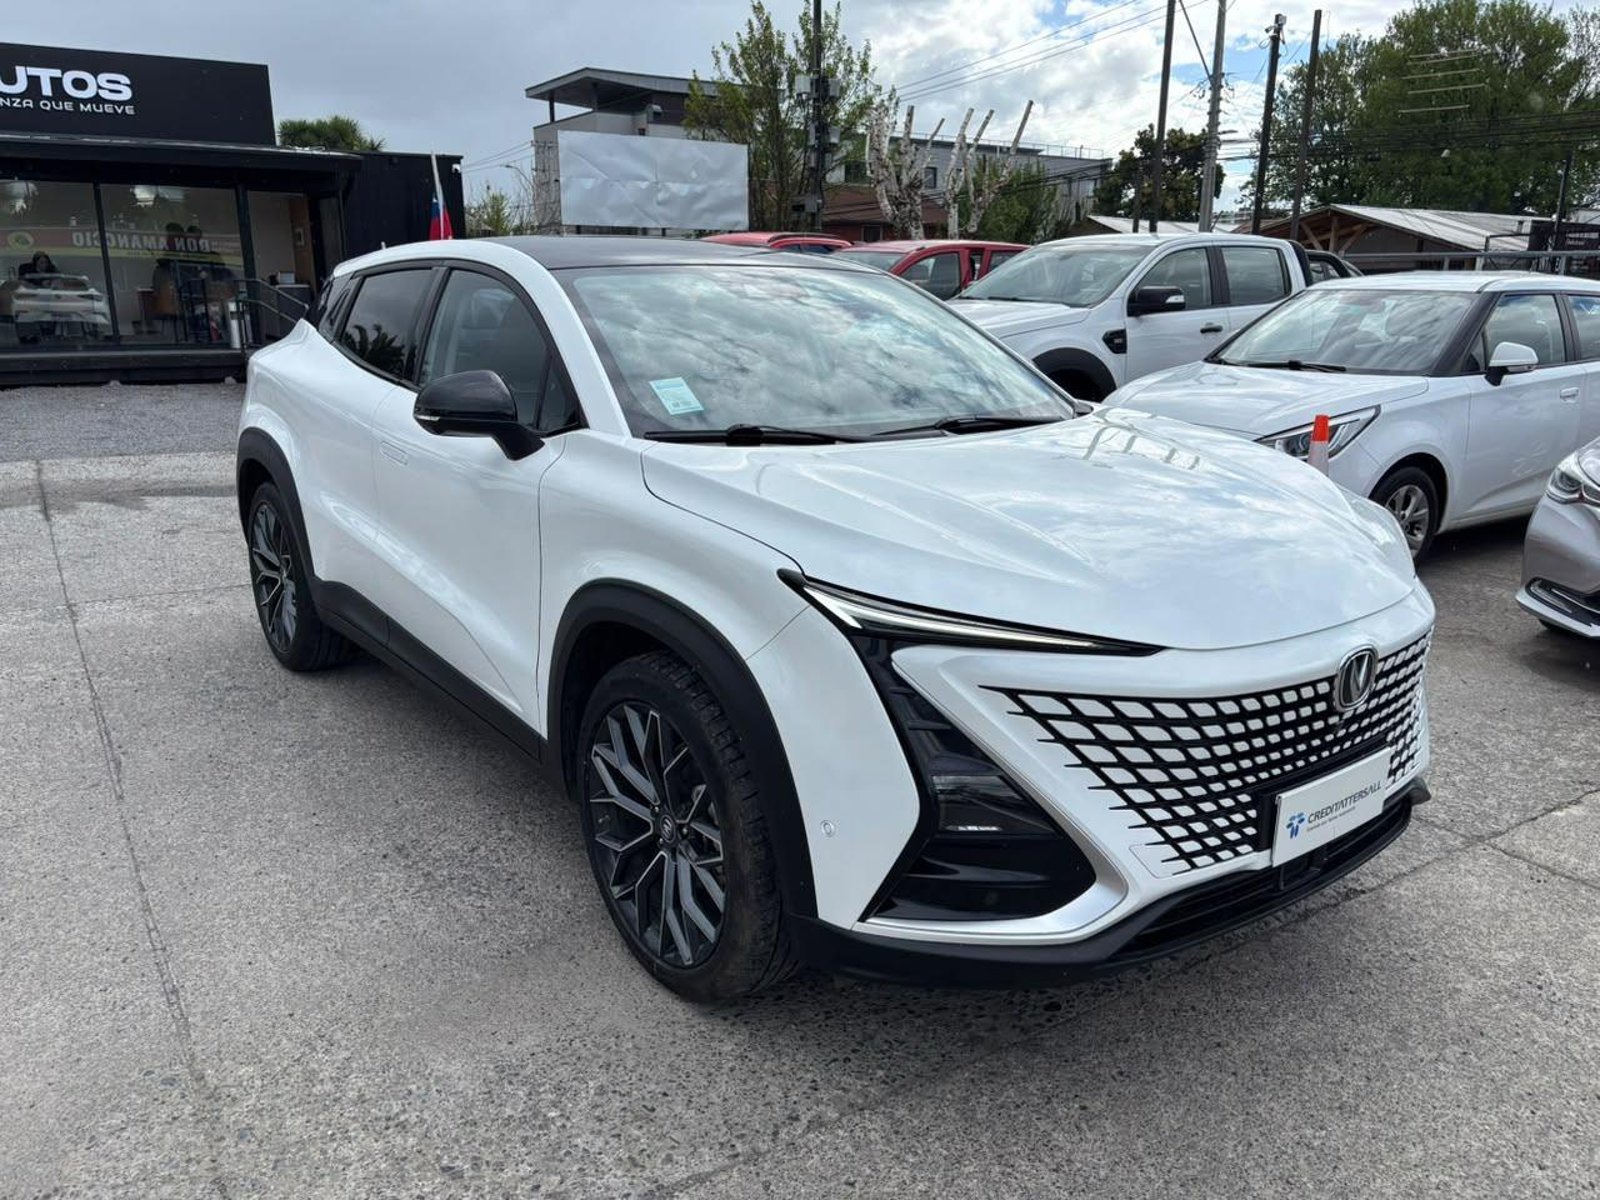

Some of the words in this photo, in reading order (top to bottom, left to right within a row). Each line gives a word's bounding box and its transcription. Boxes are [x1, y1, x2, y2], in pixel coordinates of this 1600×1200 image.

[39, 100, 74, 111] QUE
[79, 103, 136, 115] MUEVE
[1308, 781, 1381, 824] CREDITATTERSALL
